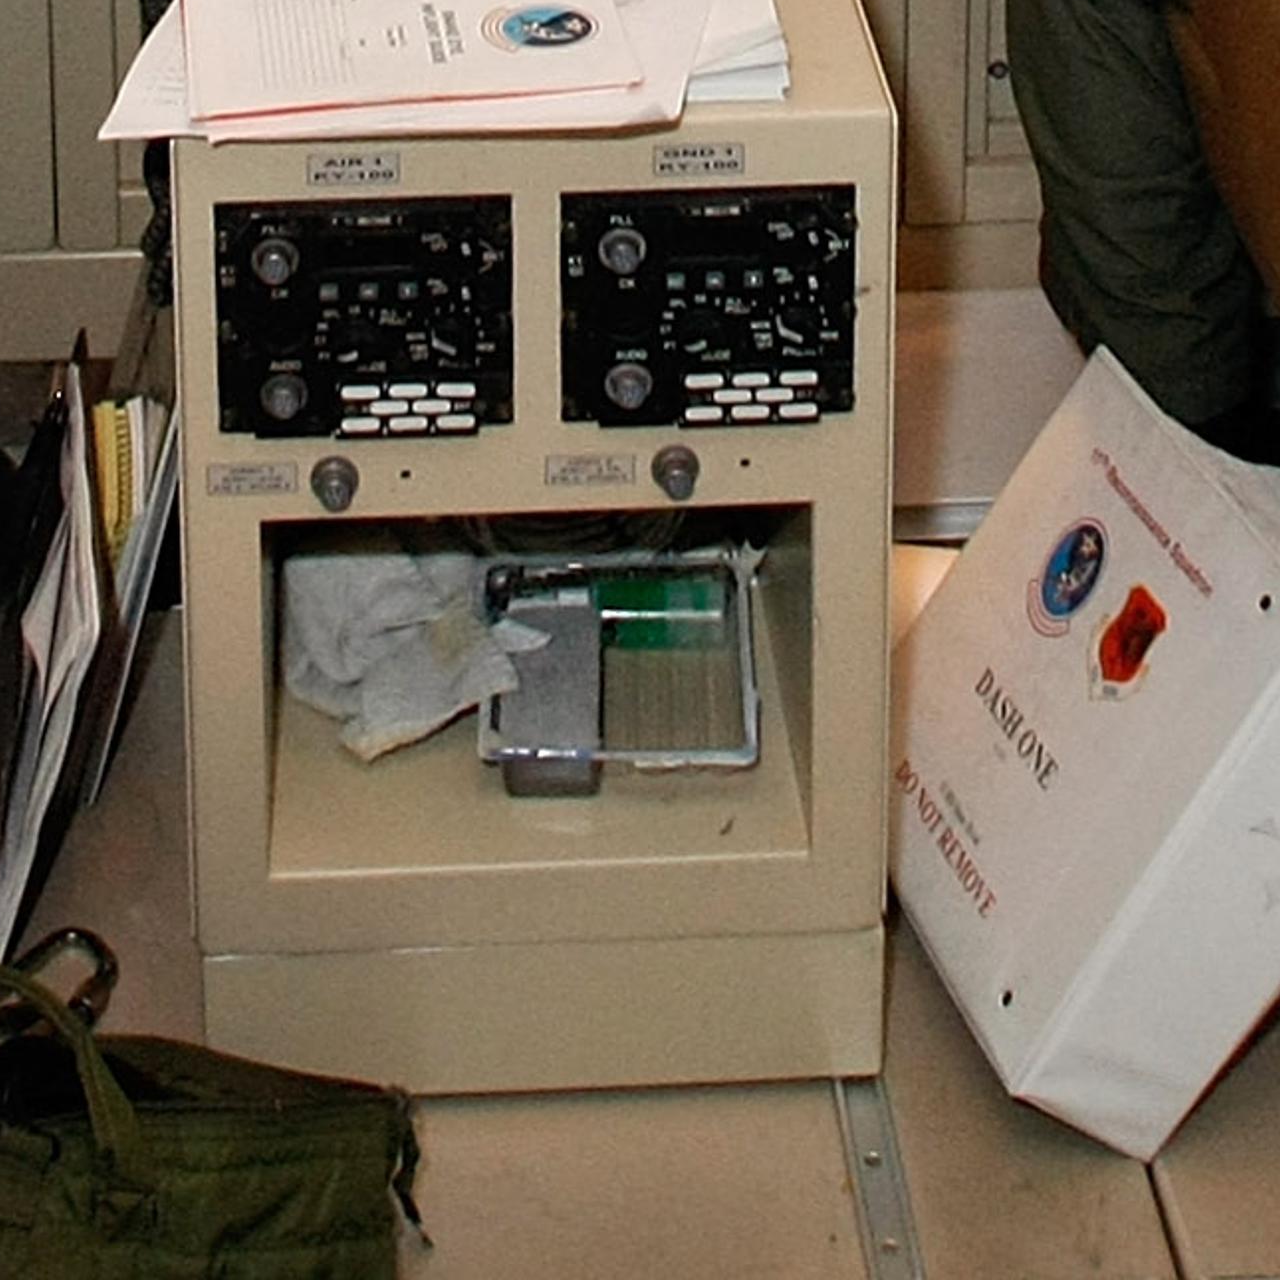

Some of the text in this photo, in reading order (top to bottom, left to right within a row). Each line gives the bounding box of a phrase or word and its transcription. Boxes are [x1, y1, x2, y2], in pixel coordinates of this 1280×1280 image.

[615, 349, 648, 360] AUDIO
[974, 666, 1060, 791] DASH ONE
[894, 759, 919, 794] DO
[913, 787, 944, 834] NOT
[937, 826, 997, 919] REMOVE
